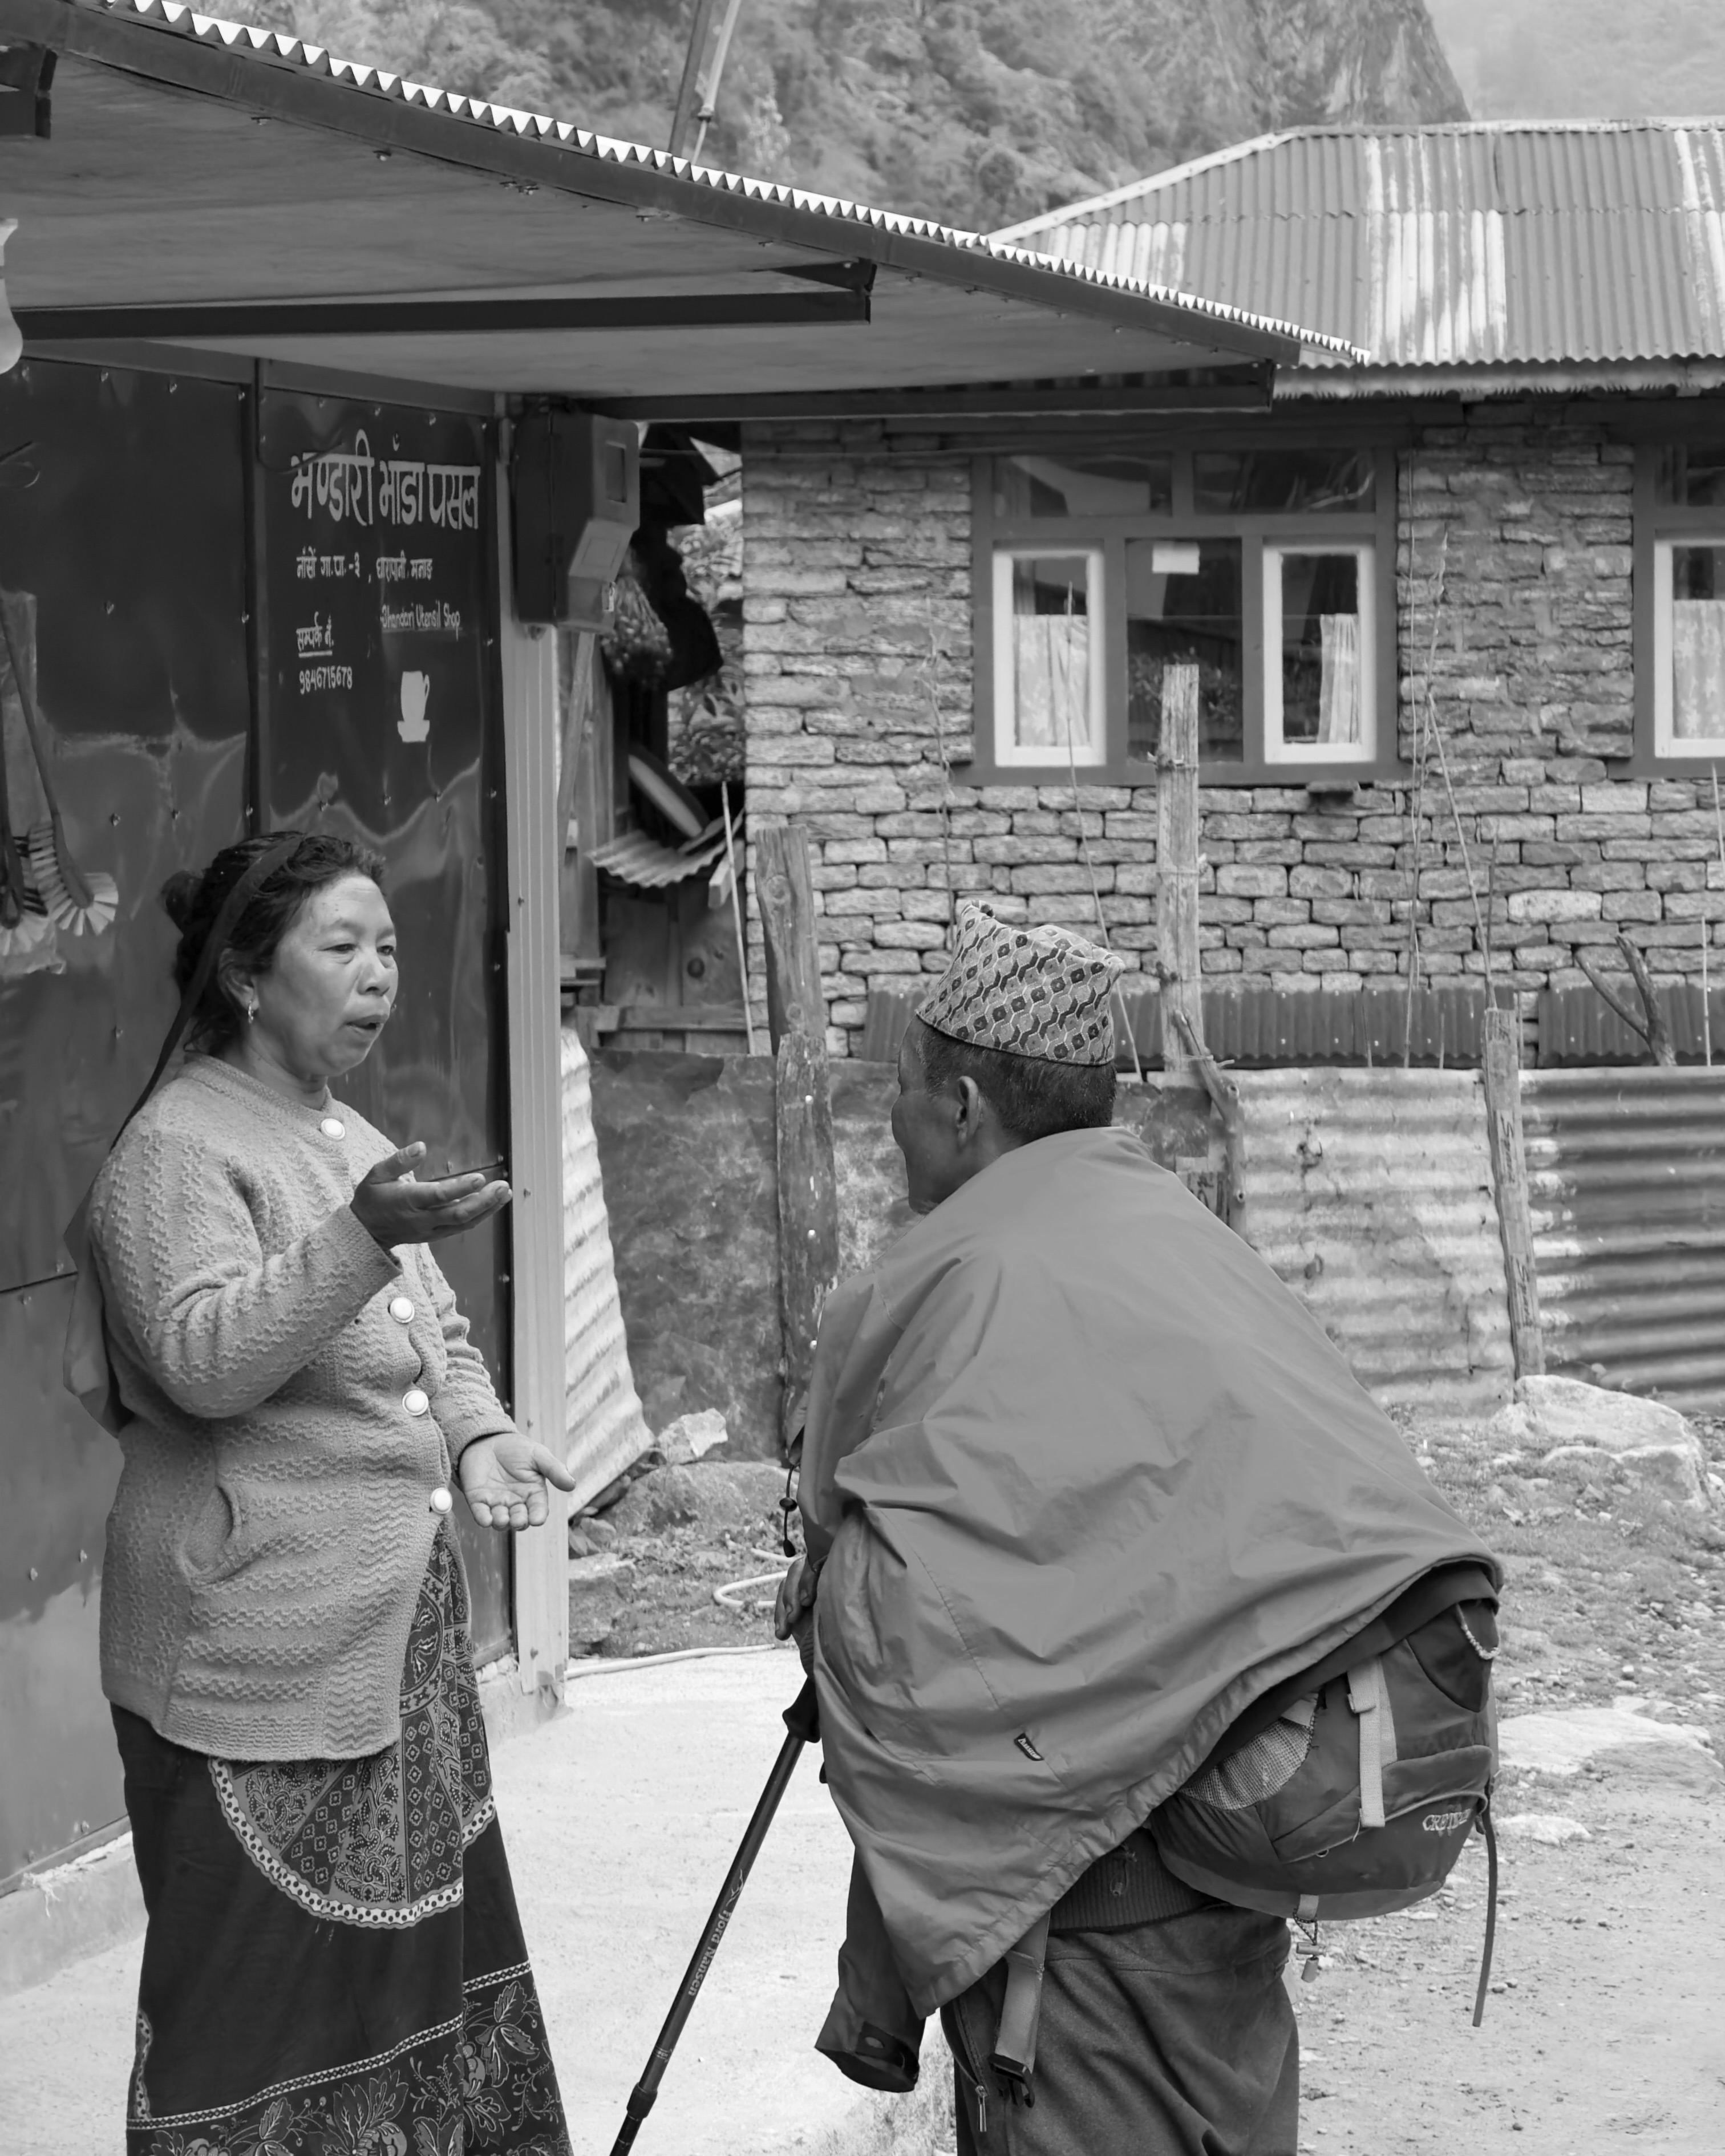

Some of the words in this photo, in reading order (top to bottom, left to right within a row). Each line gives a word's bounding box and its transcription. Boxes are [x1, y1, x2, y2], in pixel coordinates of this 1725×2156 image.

[291, 429, 375, 526] भण्डारी
[427, 464, 481, 530] पसल
[296, 611, 323, 652] सम्पर्क
[416, 599, 441, 629] Utensil
[443, 602, 460, 642] Shop
[299, 665, 353, 695] 9846715678
[711, 1910, 732, 1944] Fjord
[687, 1946, 716, 1997] Nansen
